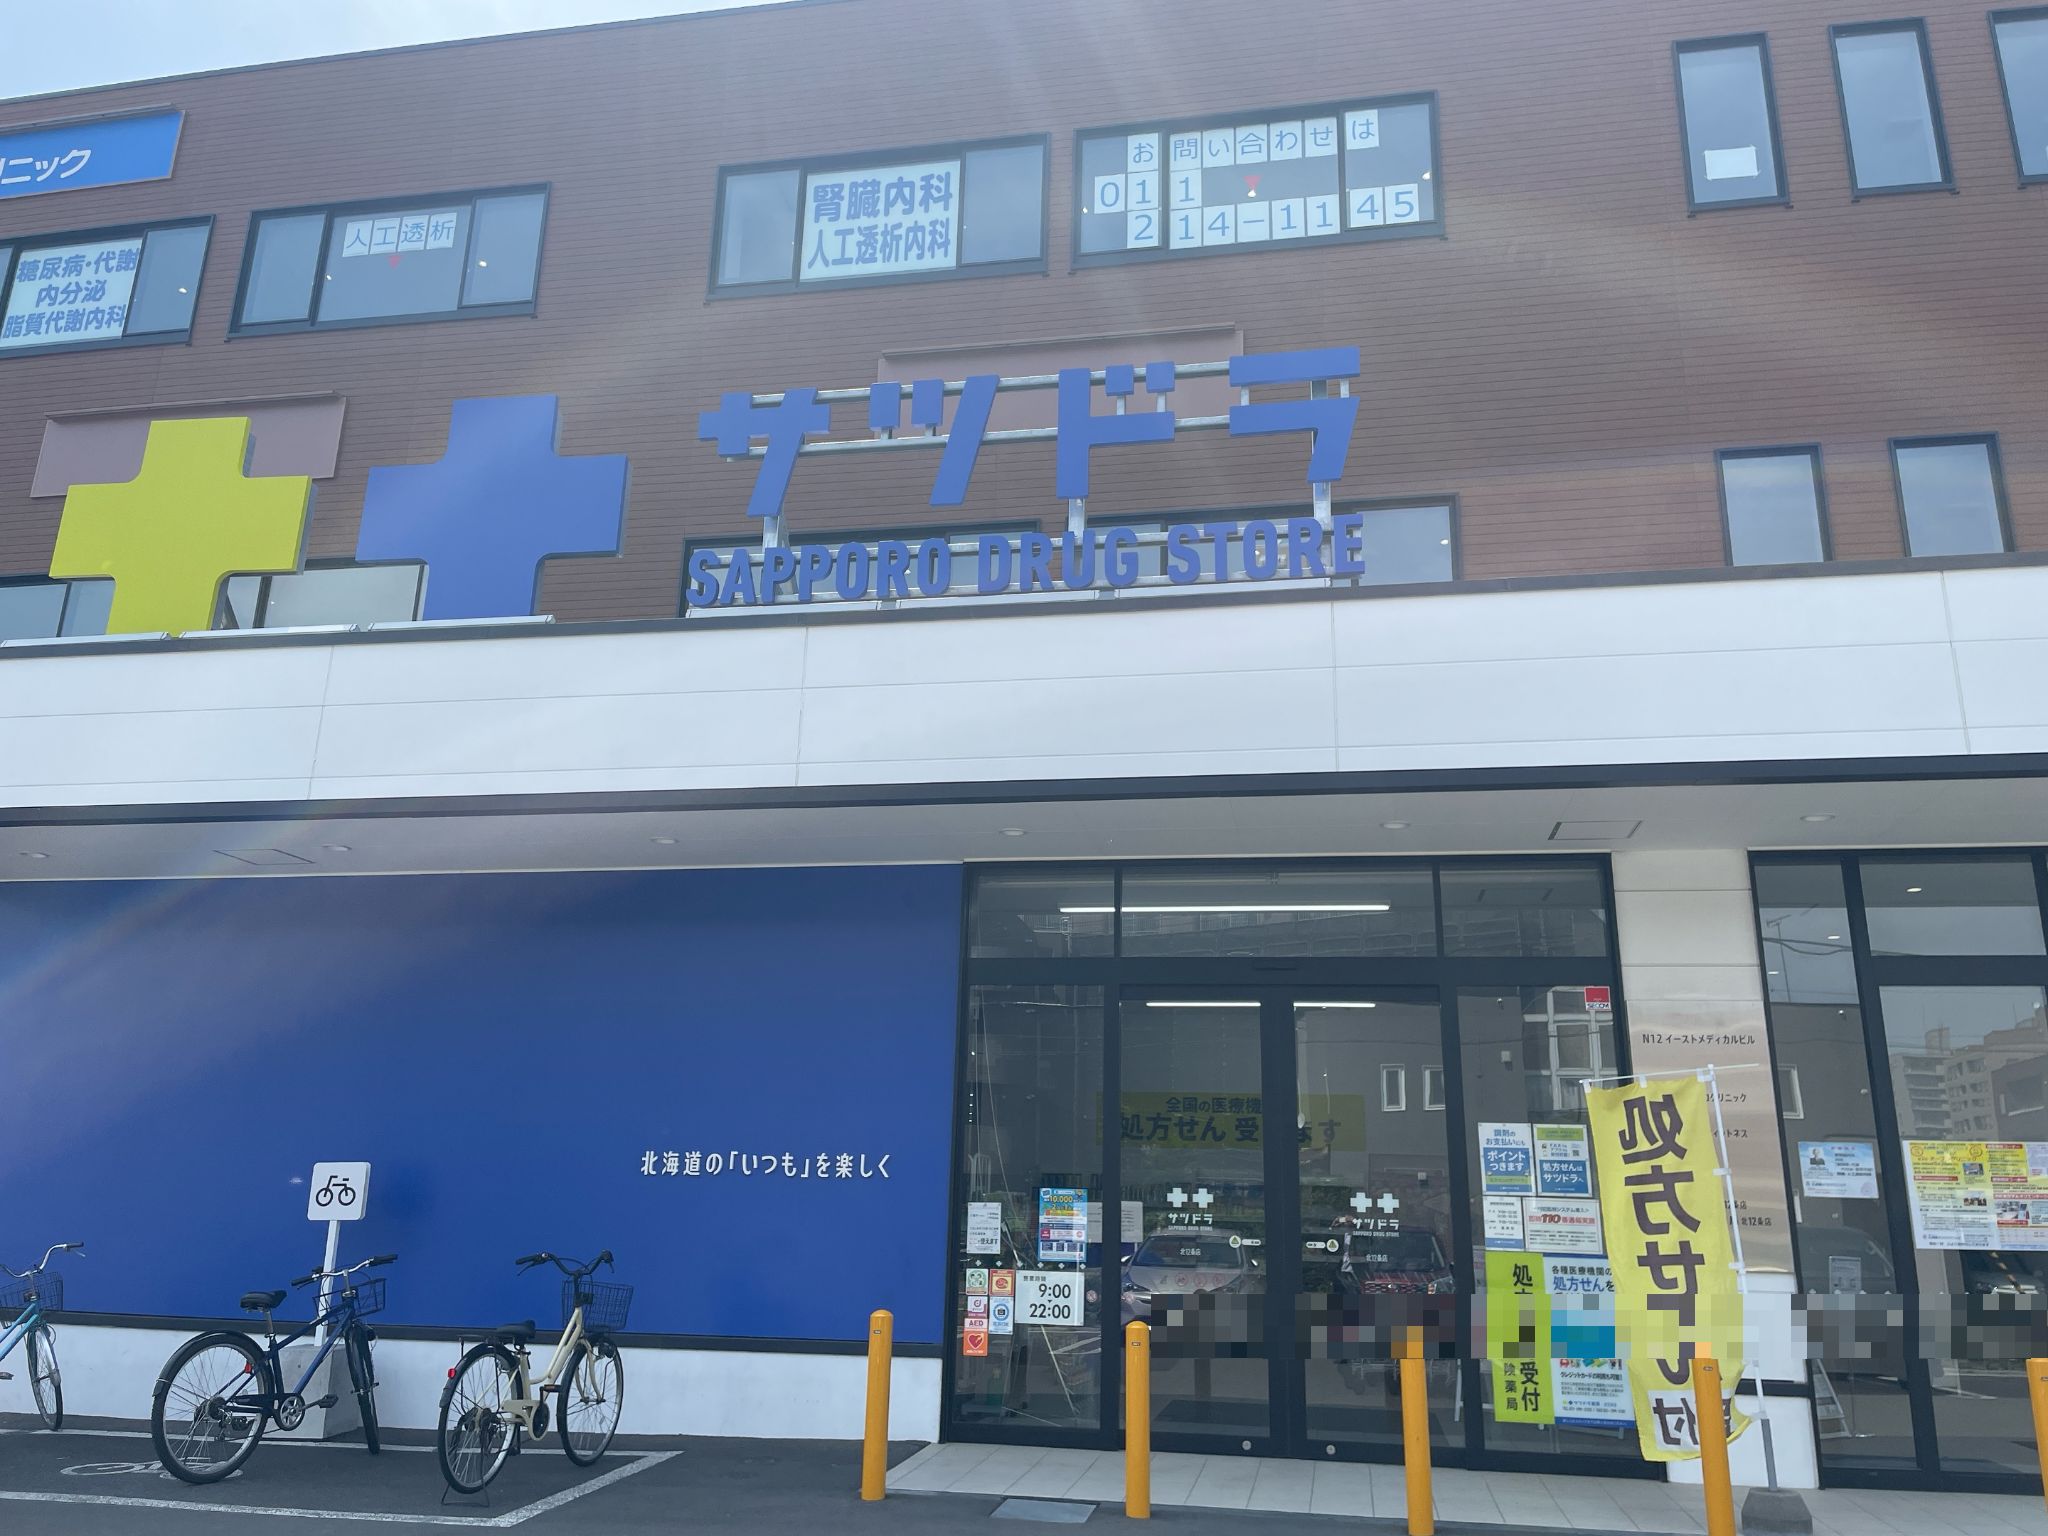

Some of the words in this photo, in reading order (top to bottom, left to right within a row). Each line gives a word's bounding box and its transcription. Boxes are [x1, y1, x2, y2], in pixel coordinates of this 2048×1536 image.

[1132, 118, 1376, 165] お問い合わせは
[813, 171, 953, 223] 腎臓内科
[1100, 176, 1196, 208] 011
[346, 219, 455, 249] 人工透析
[807, 217, 951, 269] 人工透析内科
[16, 247, 140, 283] 糖尿病・代謝
[35, 279, 108, 308] 内分泌
[2, 303, 127, 339] 脂質代謝内科
[699, 346, 1360, 517] サツドラ
[685, 537, 952, 609] SAPPORO
[977, 526, 1139, 596] DRUG
[1165, 512, 1366, 586] STORE
[1642, 1033, 1662, 1044] N12
[1665, 1034, 1755, 1045] イーストメディカルビル
[640, 1150, 891, 1179] 北海道の「いつも」を楽しく
[1487, 1150, 1526, 1162] ポイント
[1489, 1162, 1525, 1172] つきます
[1168, 1213, 1213, 1225] サツドラ
[1352, 1218, 1399, 1231] サツドラ
[1038, 1283, 1072, 1299] 9:00
[1553, 1276, 1615, 1292] 処方せんを
[968, 1319, 984, 1327] AED
[1029, 1303, 1072, 1319] 22:00
